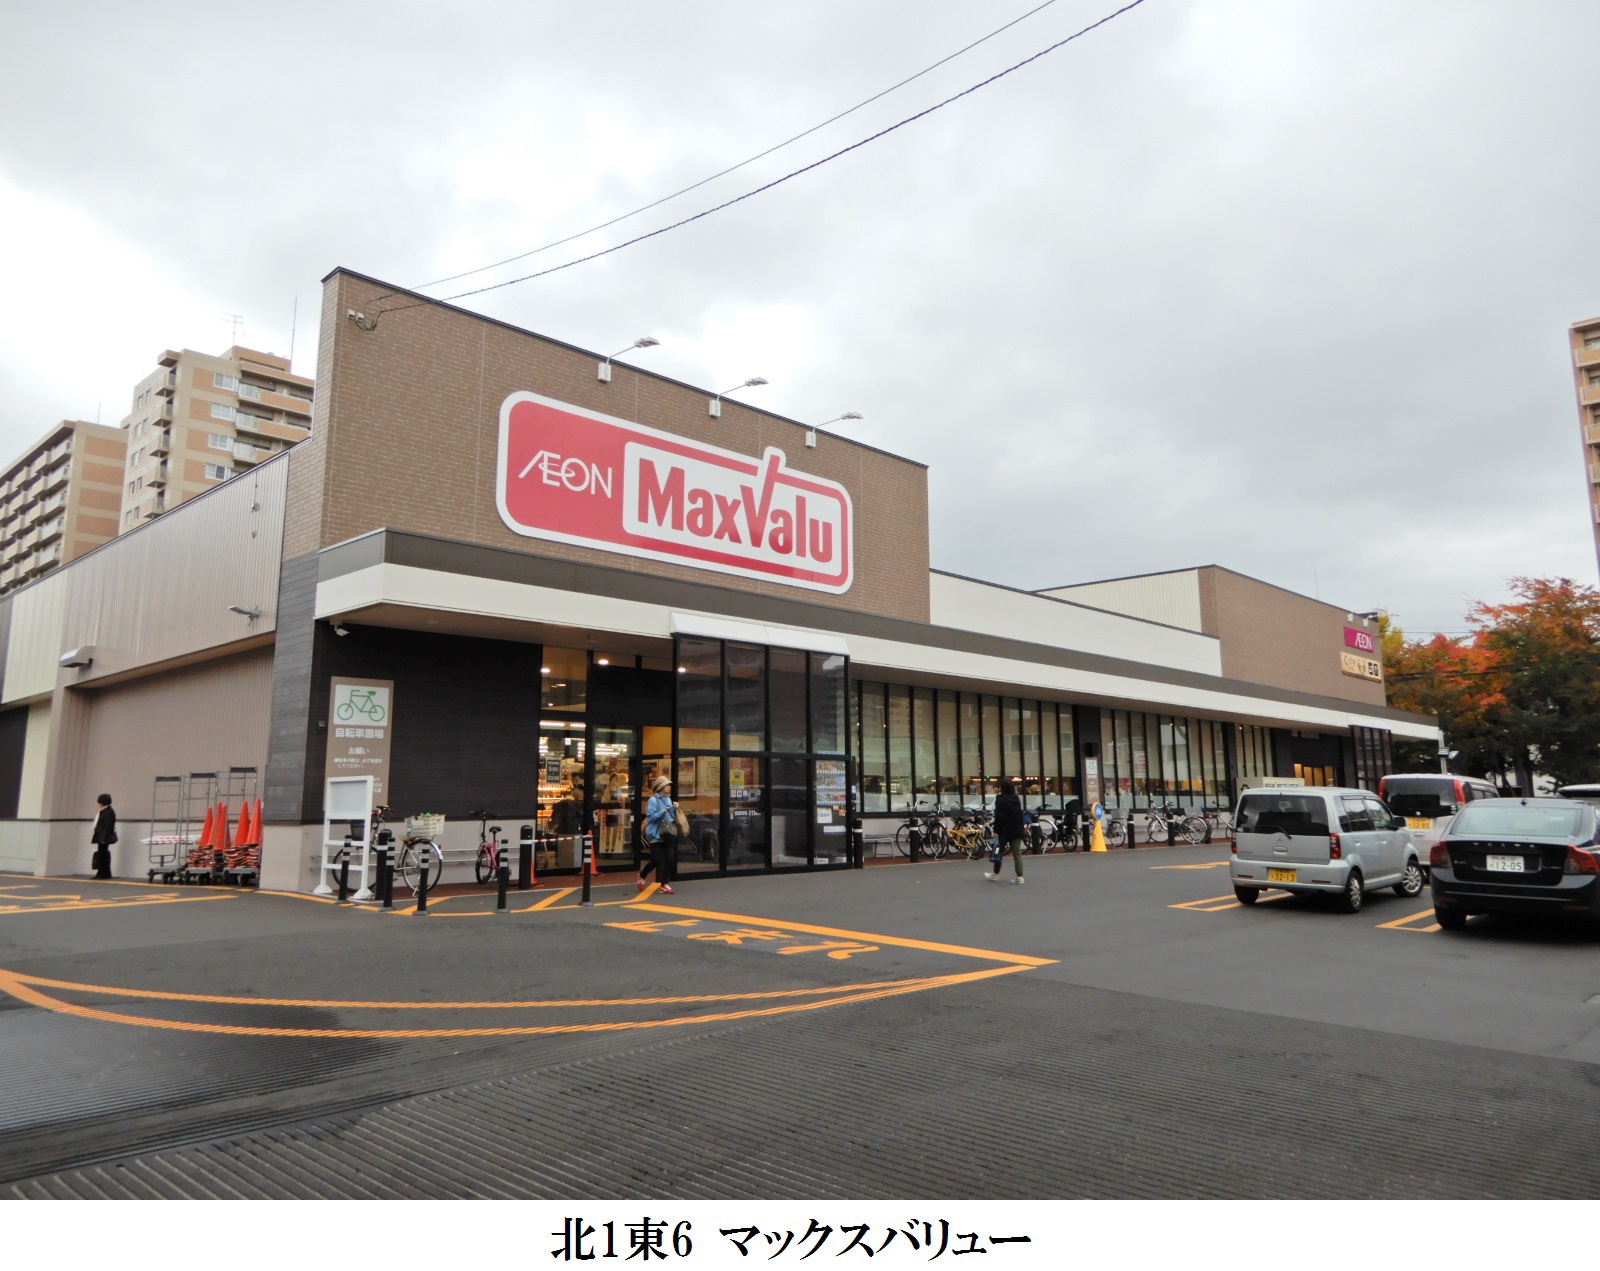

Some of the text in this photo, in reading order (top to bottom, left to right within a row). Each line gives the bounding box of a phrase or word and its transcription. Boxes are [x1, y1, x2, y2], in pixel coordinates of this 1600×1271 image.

[637, 454, 833, 563] MaxValu
[335, 727, 384, 739] 自転車置場
[348, 746, 370, 755] お願い
